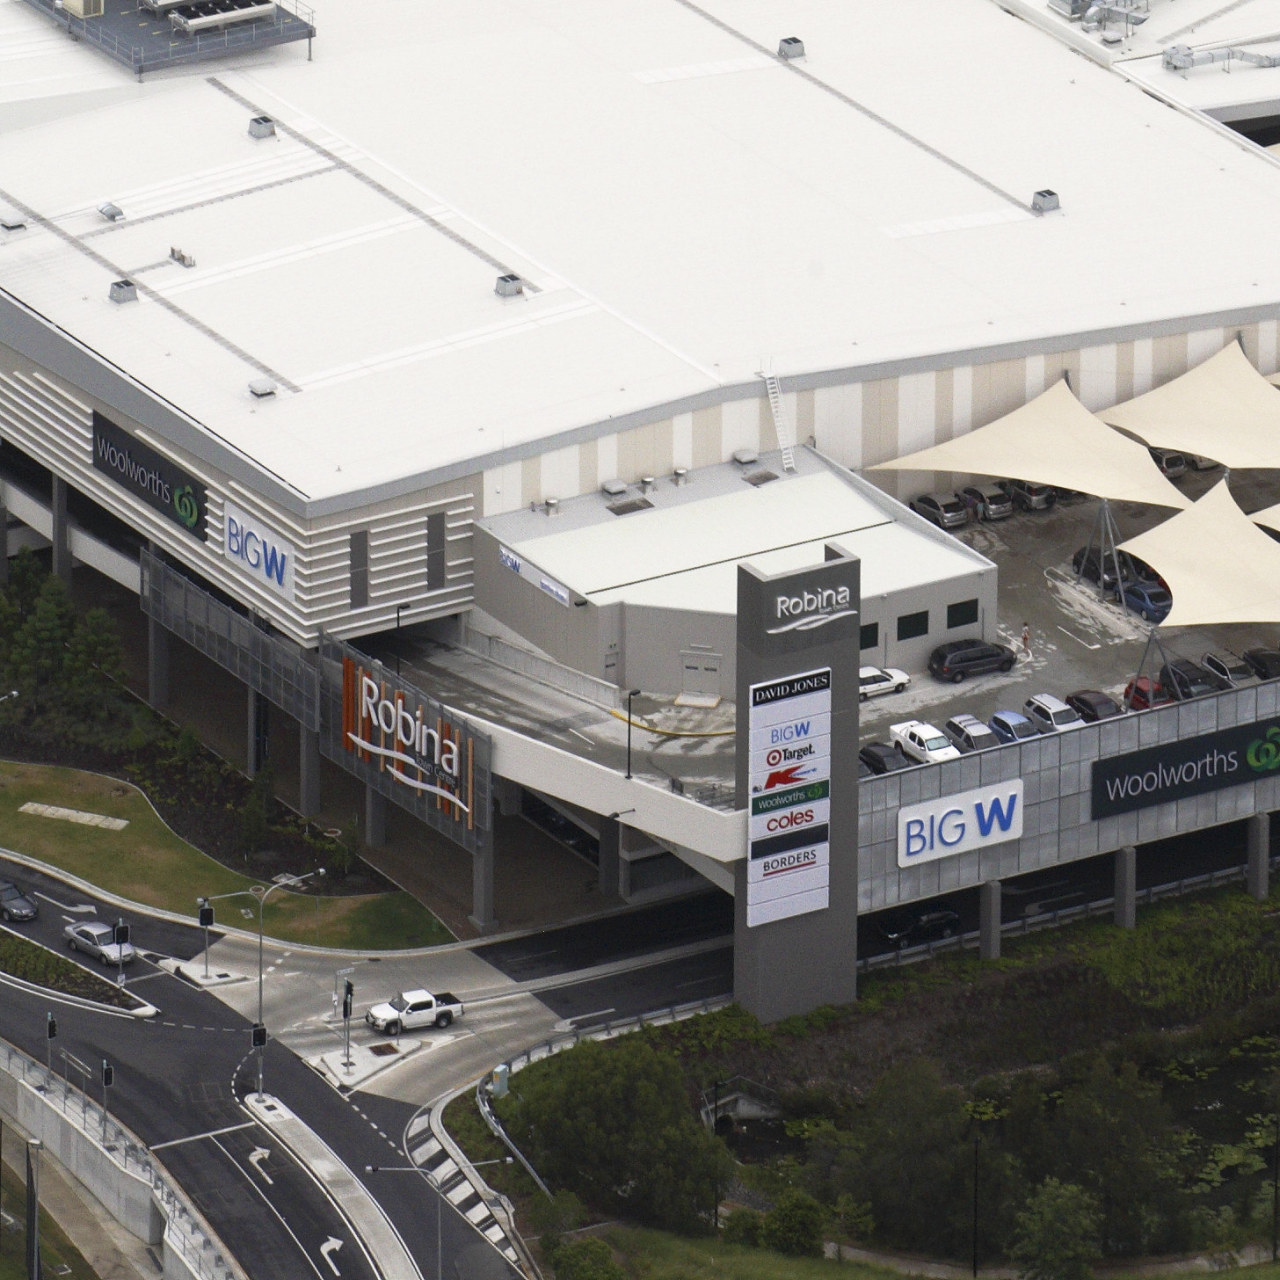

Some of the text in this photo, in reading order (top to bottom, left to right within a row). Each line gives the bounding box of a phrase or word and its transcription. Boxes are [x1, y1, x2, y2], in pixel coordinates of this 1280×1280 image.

[776, 585, 850, 619] Robina
[755, 675, 828, 702] DAVID JONES
[362, 676, 460, 777] Robina
[766, 809, 815, 832] coles
[763, 849, 817, 872] BORDERS
